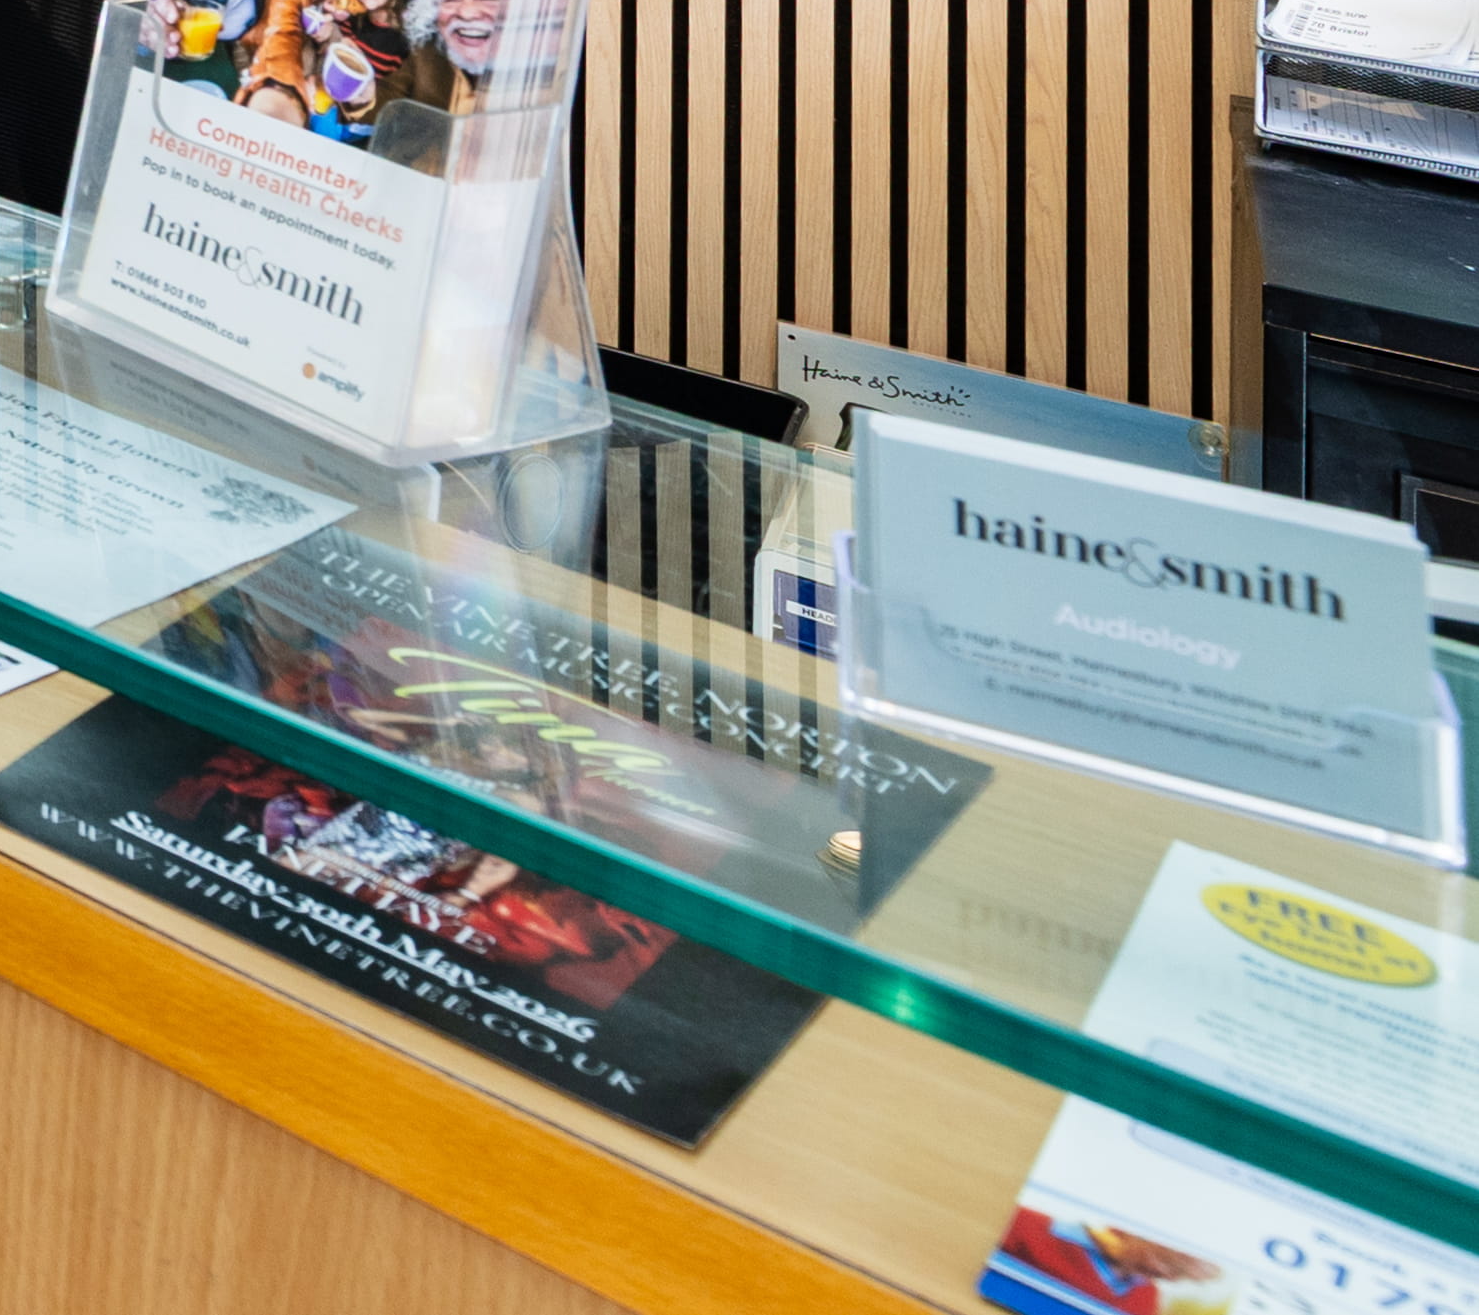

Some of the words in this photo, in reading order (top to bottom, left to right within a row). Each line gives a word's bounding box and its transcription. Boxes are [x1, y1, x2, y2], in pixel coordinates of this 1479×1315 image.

[149, 127, 233, 178] Hearing
[239, 166, 312, 207] Health
[319, 194, 404, 244] Checks
[197, 118, 368, 200] Complimentary
[142, 156, 167, 177] Pop
[170, 167, 183, 181] in
[185, 174, 200, 188] to
[202, 180, 236, 204] book
[239, 196, 256, 213] an
[259, 203, 349, 252] appointment
[353, 243, 397, 270] today.
[142, 202, 364, 326] haine&smith
[110, 276, 251, 349] www.haineandsmith.co.uk
[317, 371, 366, 402] amplify
[802, 355, 862, 386] Haine
[868, 377, 884, 390] &
[883, 375, 971, 407] Smith
[2, 429, 105, 475] Naturally
[108, 473, 185, 509] Grown
[108, 438, 201, 479] Flowers
[952, 496, 1348, 623] haine&smith
[319, 546, 411, 595] THE
[423, 585, 538, 642] VINE
[693, 688, 959, 795] NORTON
[1053, 602, 1242, 670] Audiology
[322, 573, 425, 622] OPEN
[433, 618, 508, 654] AIR
[516, 647, 653, 706] MUSIC
[665, 702, 907, 794] CONCERT
[39, 801, 643, 1096] WWW.THEVINETREE.CO.UK
[111, 810, 289, 893] Saturday
[281, 888, 383, 945] 30th
[391, 933, 489, 989] May
[489, 984, 598, 1043] 2026
[1247, 888, 1384, 948] FREE
[1264, 1238, 1464, 1315] 017
